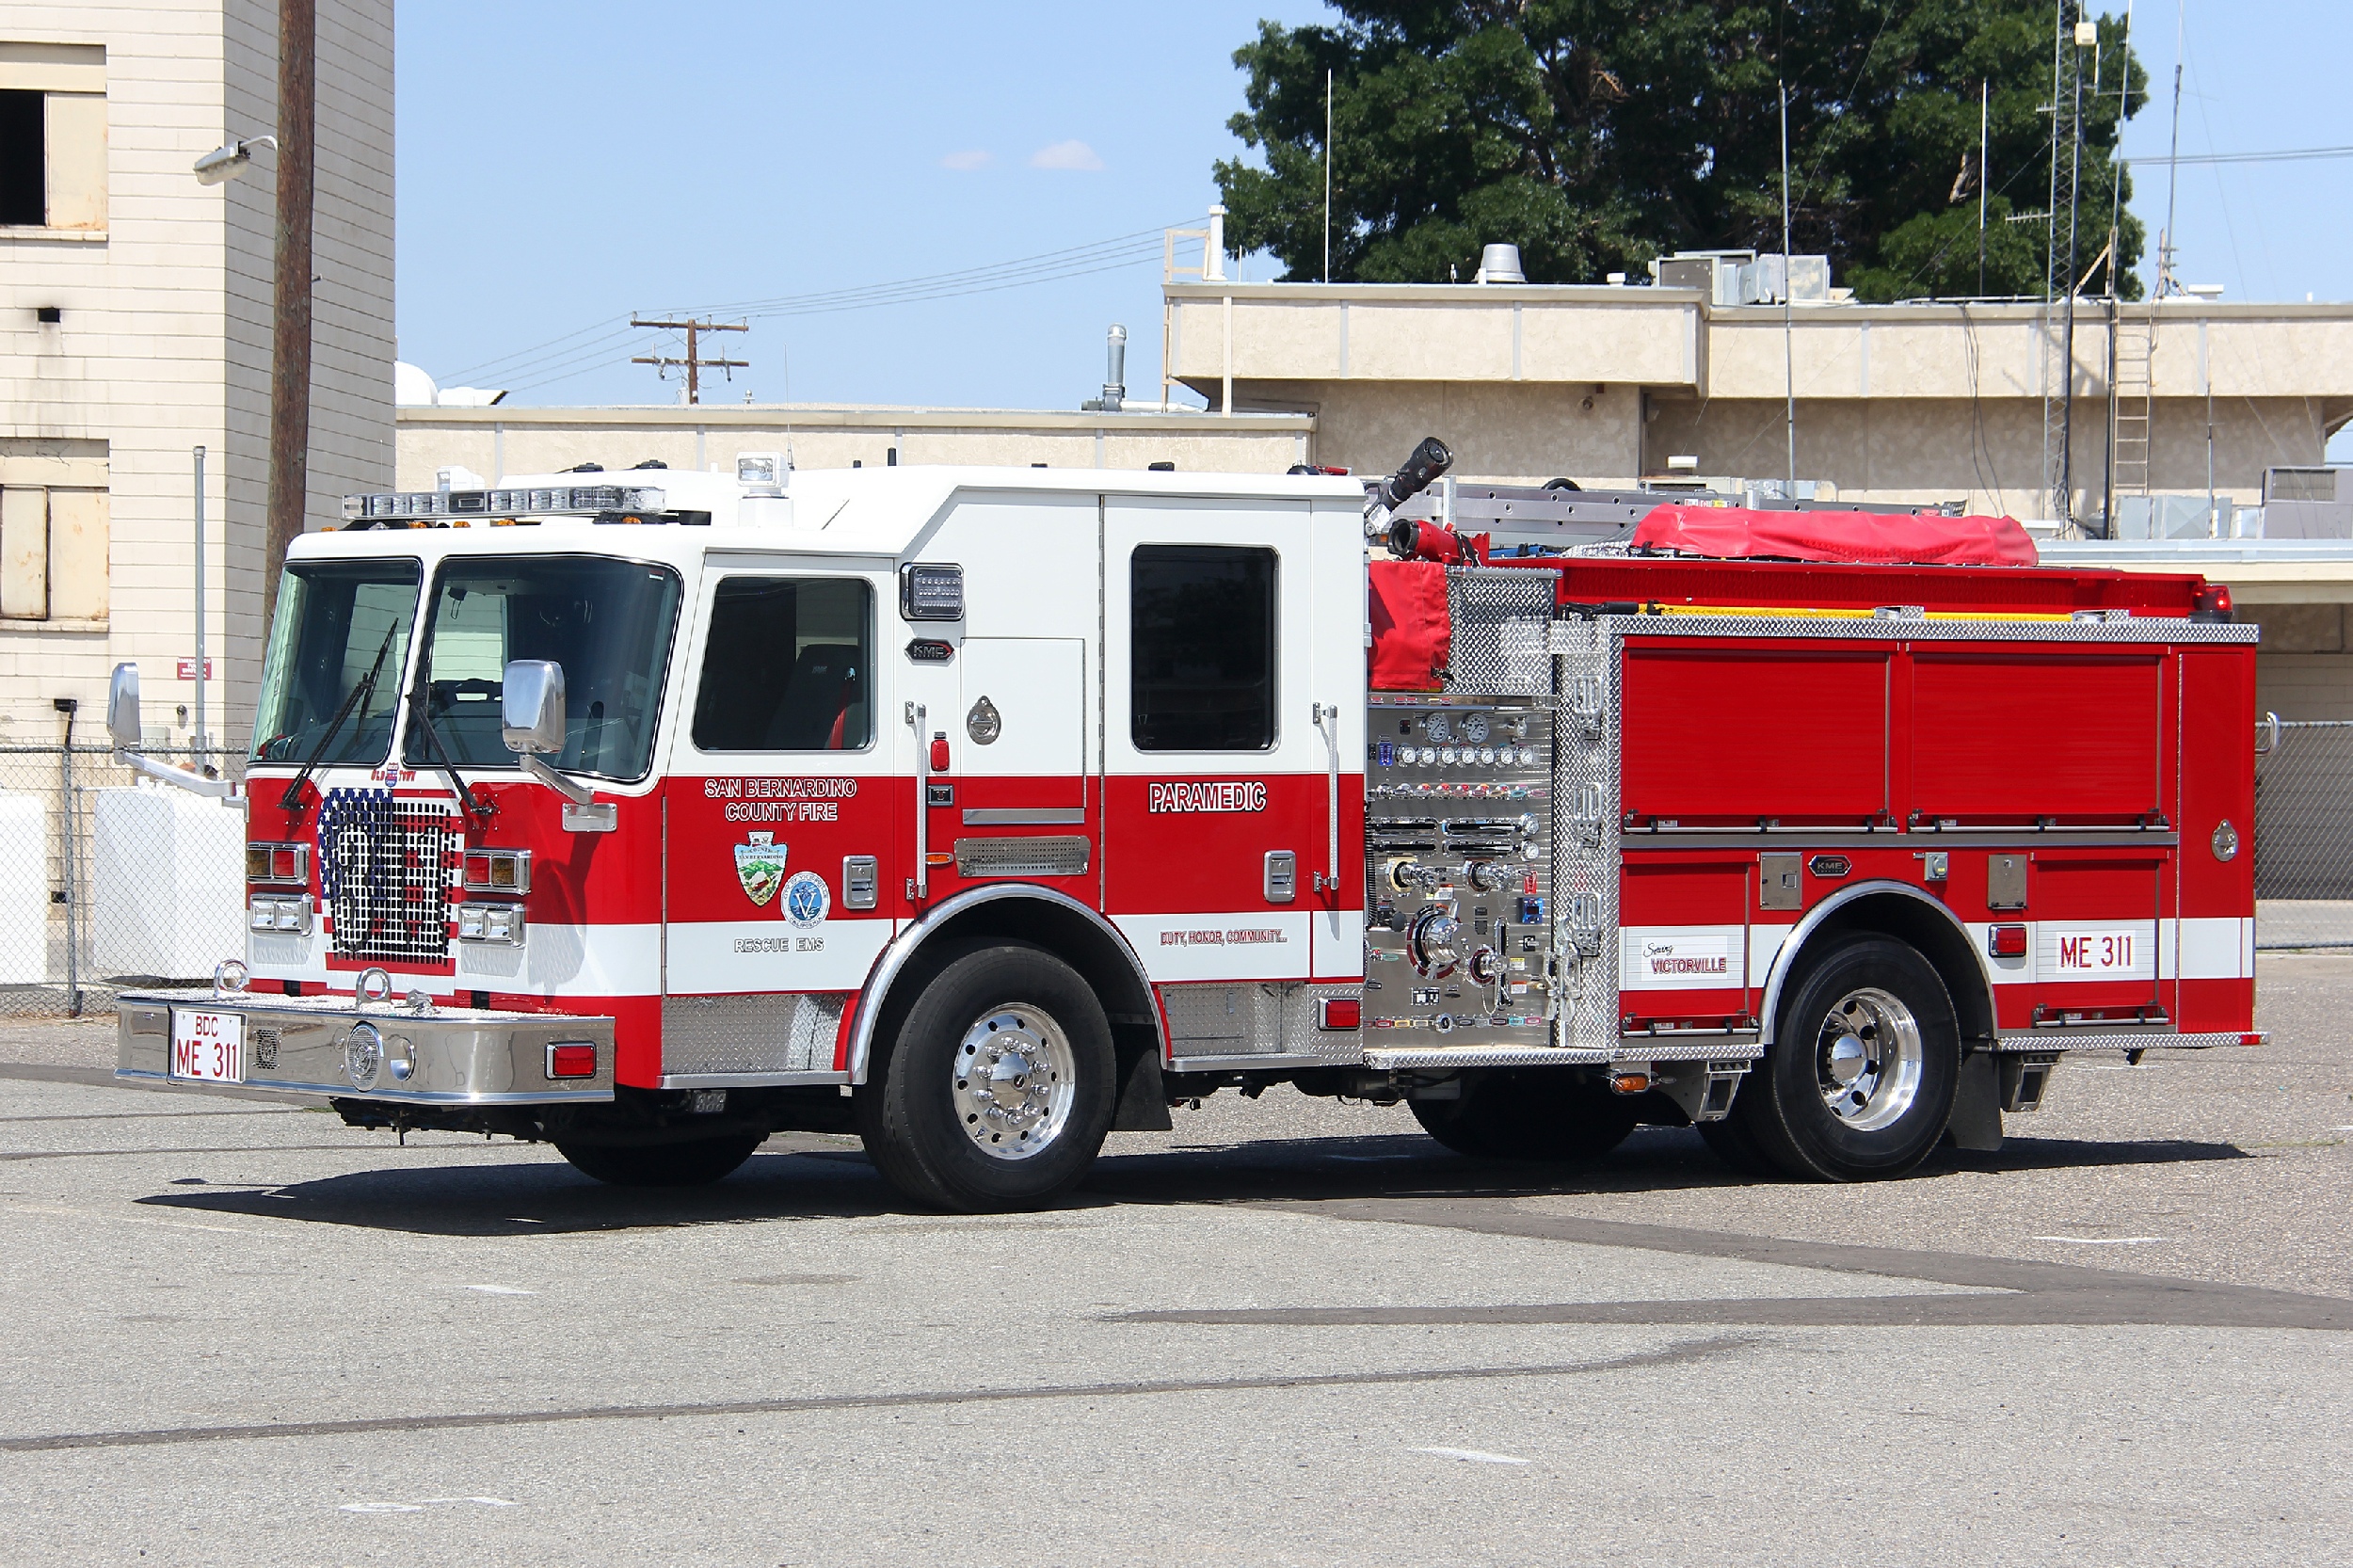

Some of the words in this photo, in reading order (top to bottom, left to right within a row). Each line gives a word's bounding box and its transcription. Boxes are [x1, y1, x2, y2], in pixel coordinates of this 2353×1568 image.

[913, 645, 944, 655] KME
[371, 769, 386, 781] OLD
[704, 778, 742, 798] SAN
[744, 778, 857, 798] BERNARDINO
[1149, 782, 1267, 812] PARAMEDIC
[725, 802, 797, 822] COUNTY
[799, 802, 838, 822] FIRE
[1817, 861, 1843, 870] KME
[734, 937, 790, 953] RESCUE
[795, 936, 825, 952] EMS
[1160, 931, 1187, 948] DUTY,
[1188, 930, 1225, 947] HONOR,
[2060, 936, 2092, 968] ME
[2100, 935, 2131, 968] 311
[1650, 957, 1727, 975] VICTORVILLE
[195, 1015, 218, 1038] BDC
[176, 1038, 202, 1077] ME
[212, 1042, 237, 1080] 311
